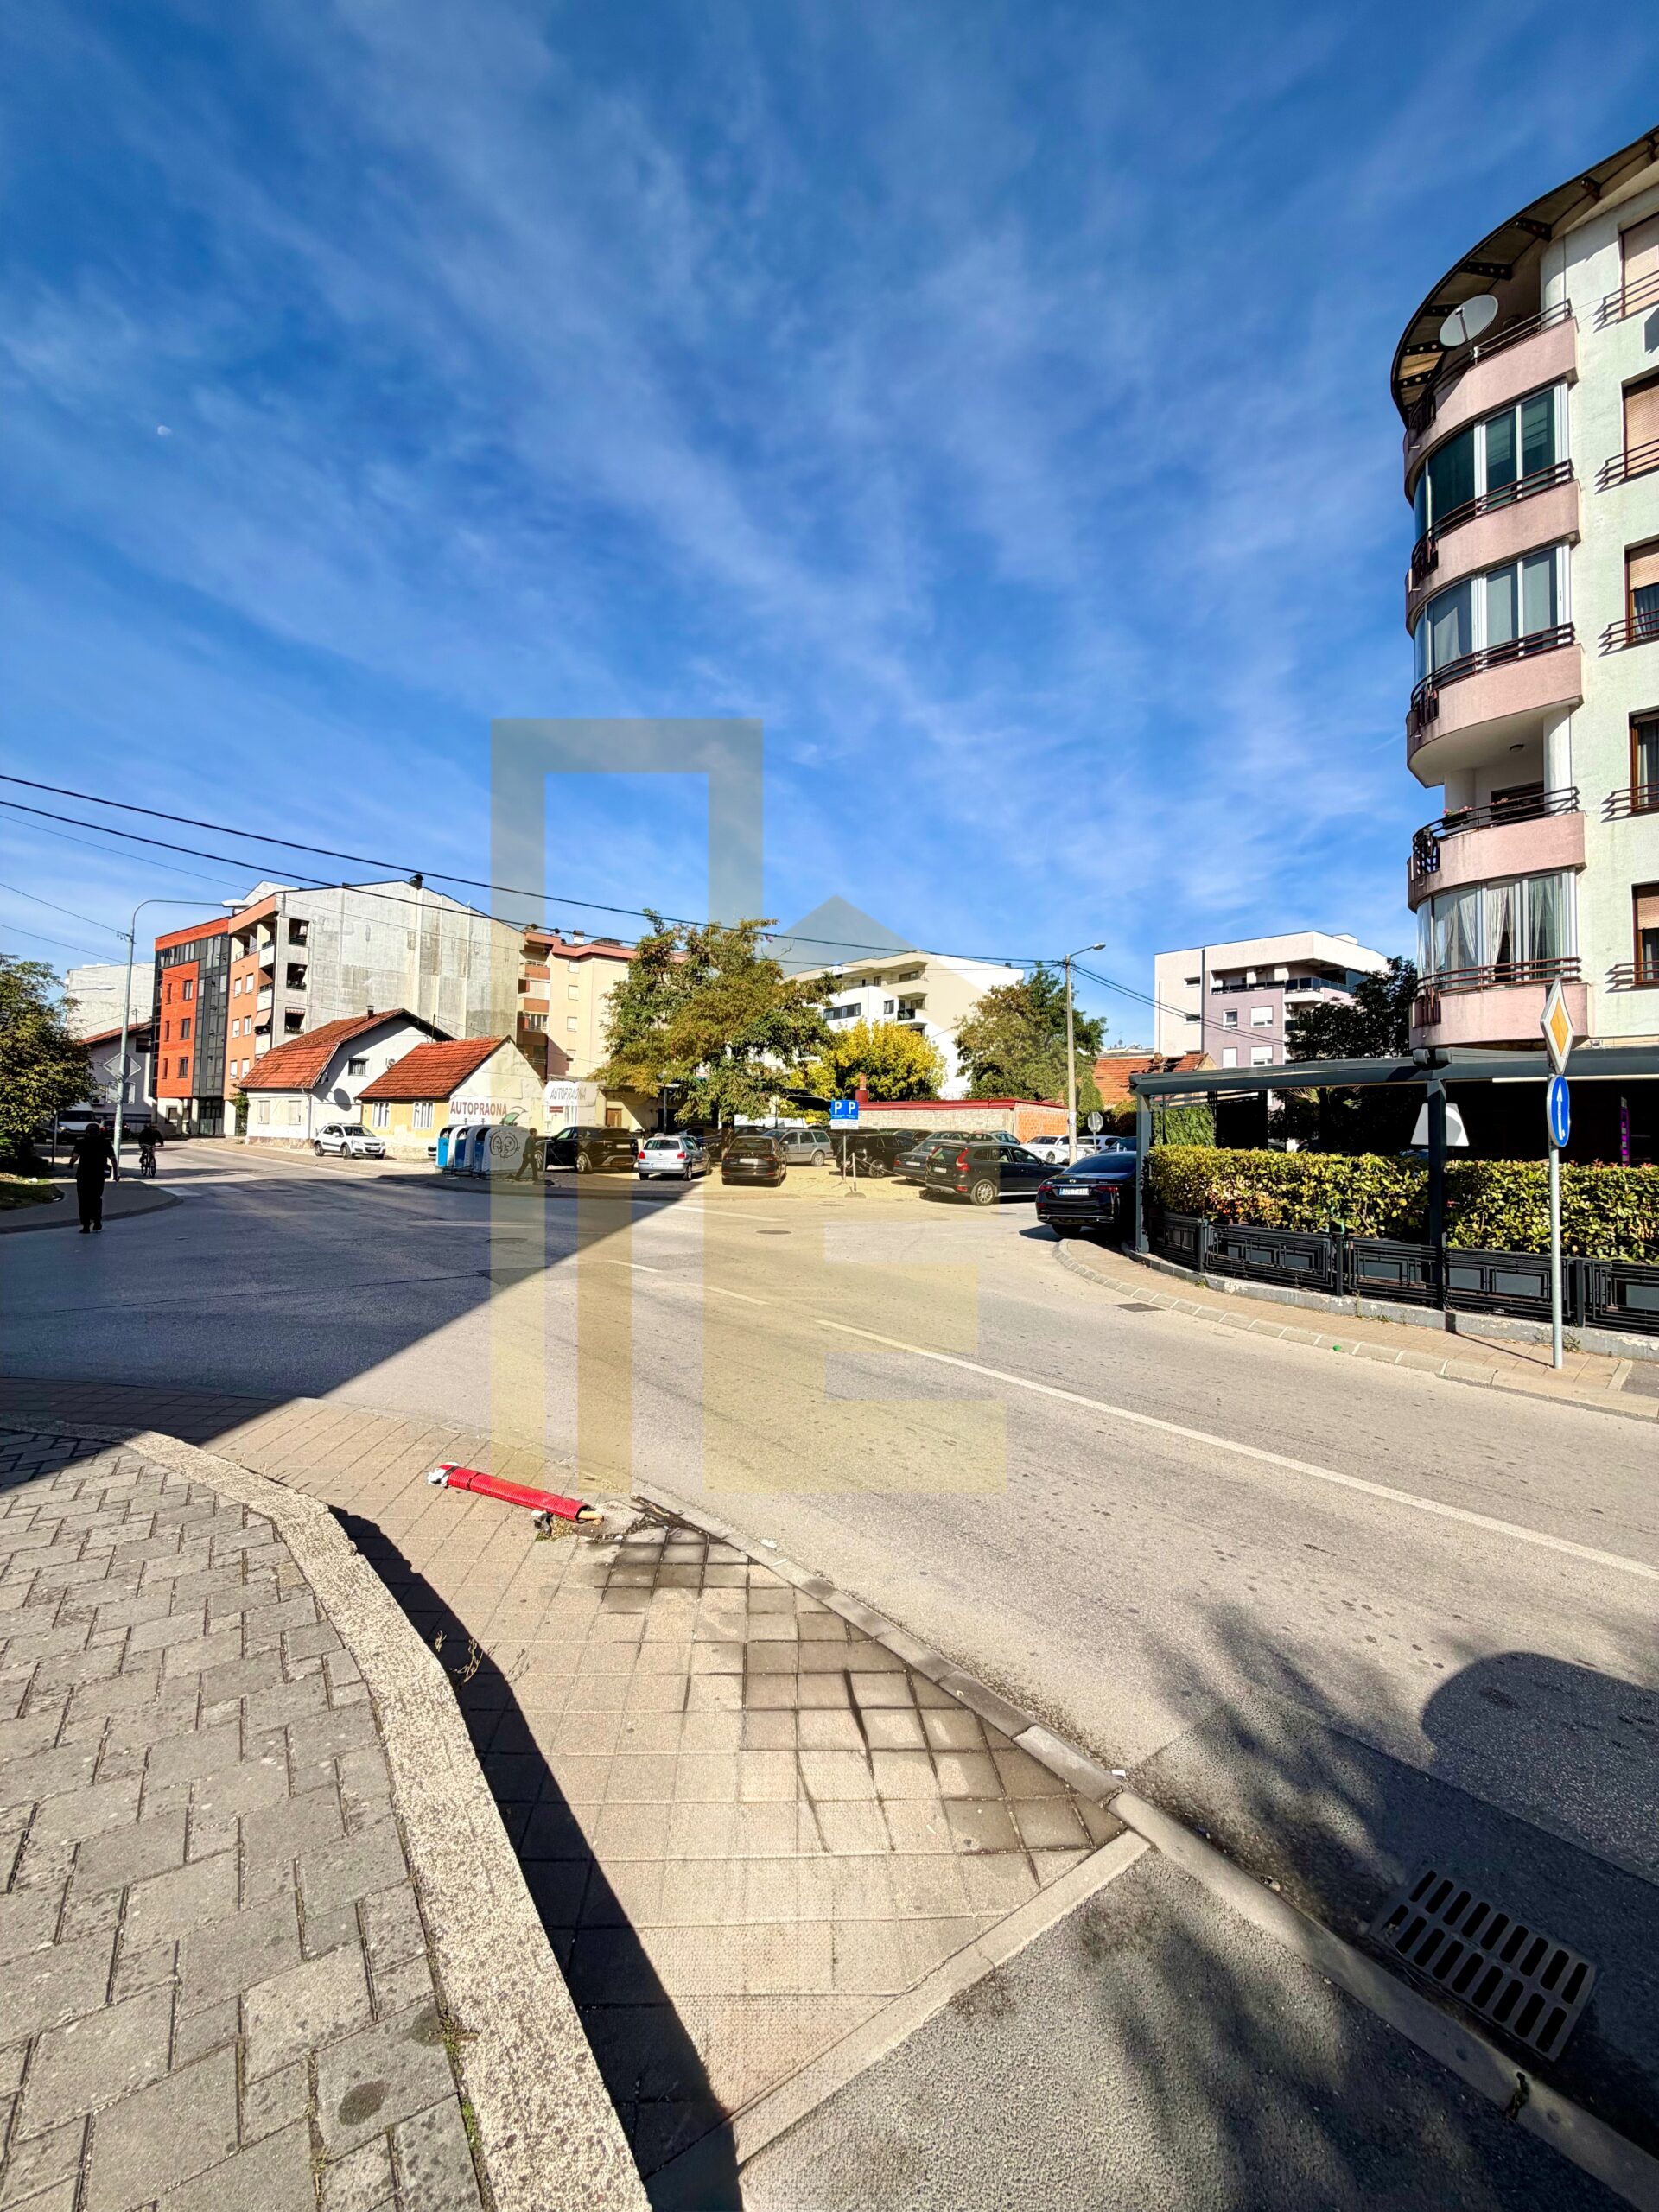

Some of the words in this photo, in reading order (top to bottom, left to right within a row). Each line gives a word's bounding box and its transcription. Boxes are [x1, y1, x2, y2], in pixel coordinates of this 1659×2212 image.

[450, 1101, 507, 1116] AUTOPRAONA
[834, 1101, 842, 1114] P
[849, 1101, 855, 1114] P
